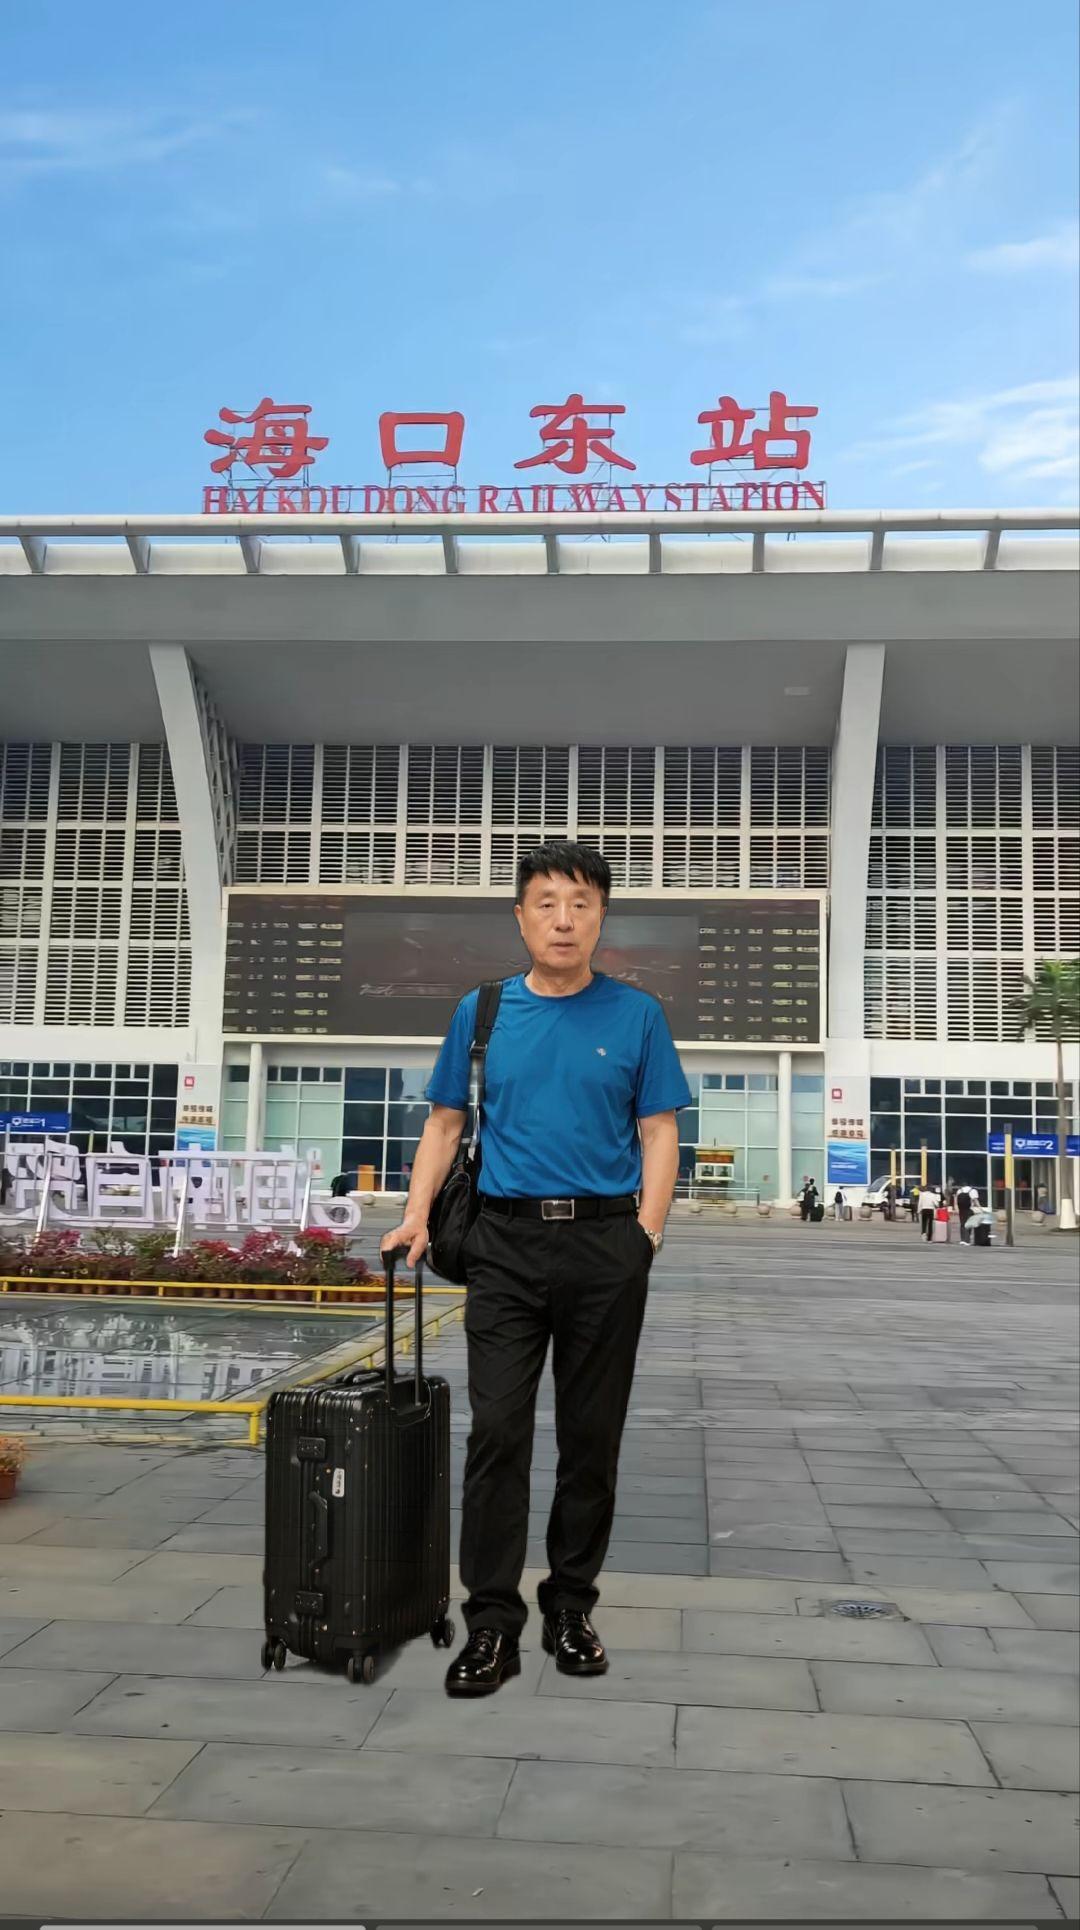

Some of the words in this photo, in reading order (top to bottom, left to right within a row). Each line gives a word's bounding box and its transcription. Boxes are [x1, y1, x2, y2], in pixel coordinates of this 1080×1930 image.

[203, 391, 819, 479] 海口东站
[361, 484, 465, 514] DONG
[478, 482, 654, 513] RAILWAY
[663, 481, 826, 511] STATION
